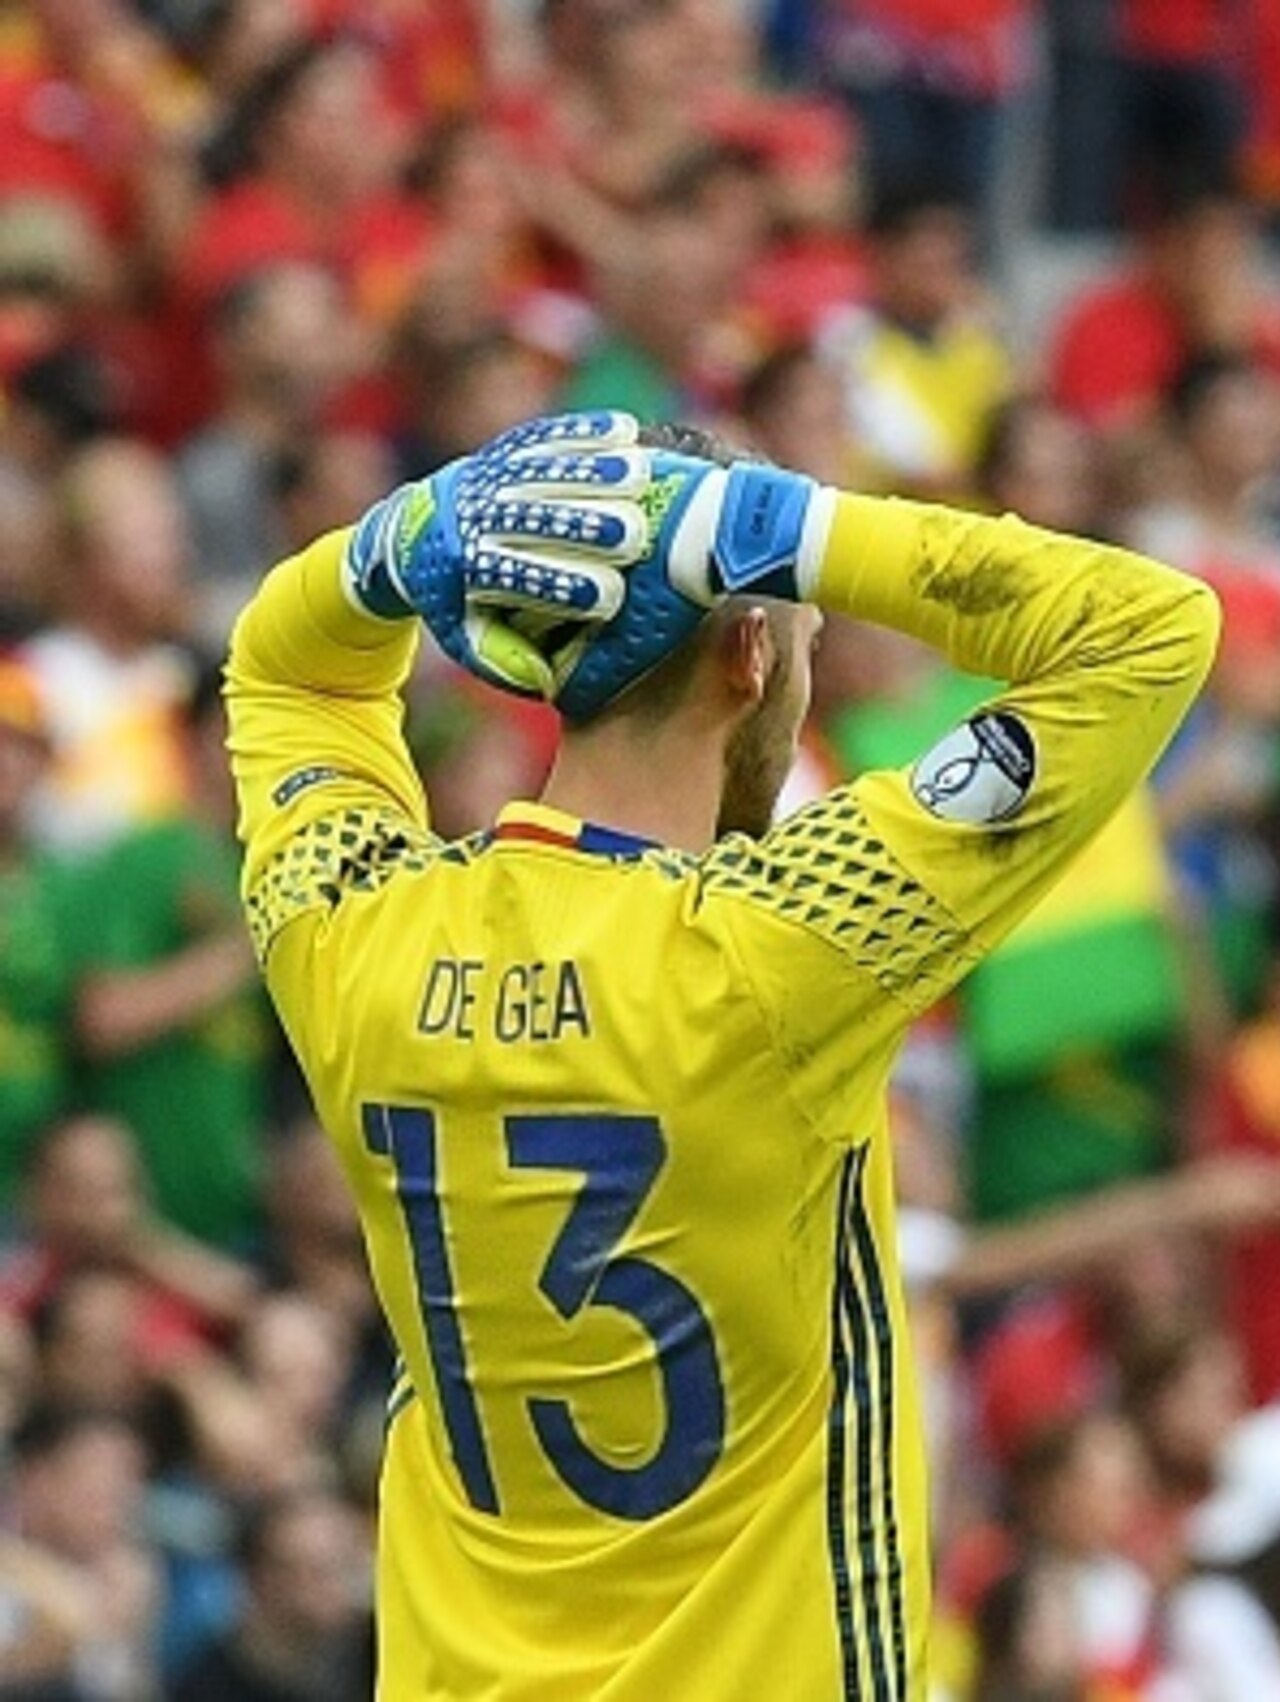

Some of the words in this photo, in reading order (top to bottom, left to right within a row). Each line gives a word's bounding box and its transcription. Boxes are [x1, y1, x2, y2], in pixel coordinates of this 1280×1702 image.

[417, 959, 484, 1039] DE
[495, 959, 591, 1043] GEA
[361, 1102, 726, 1521] 13
